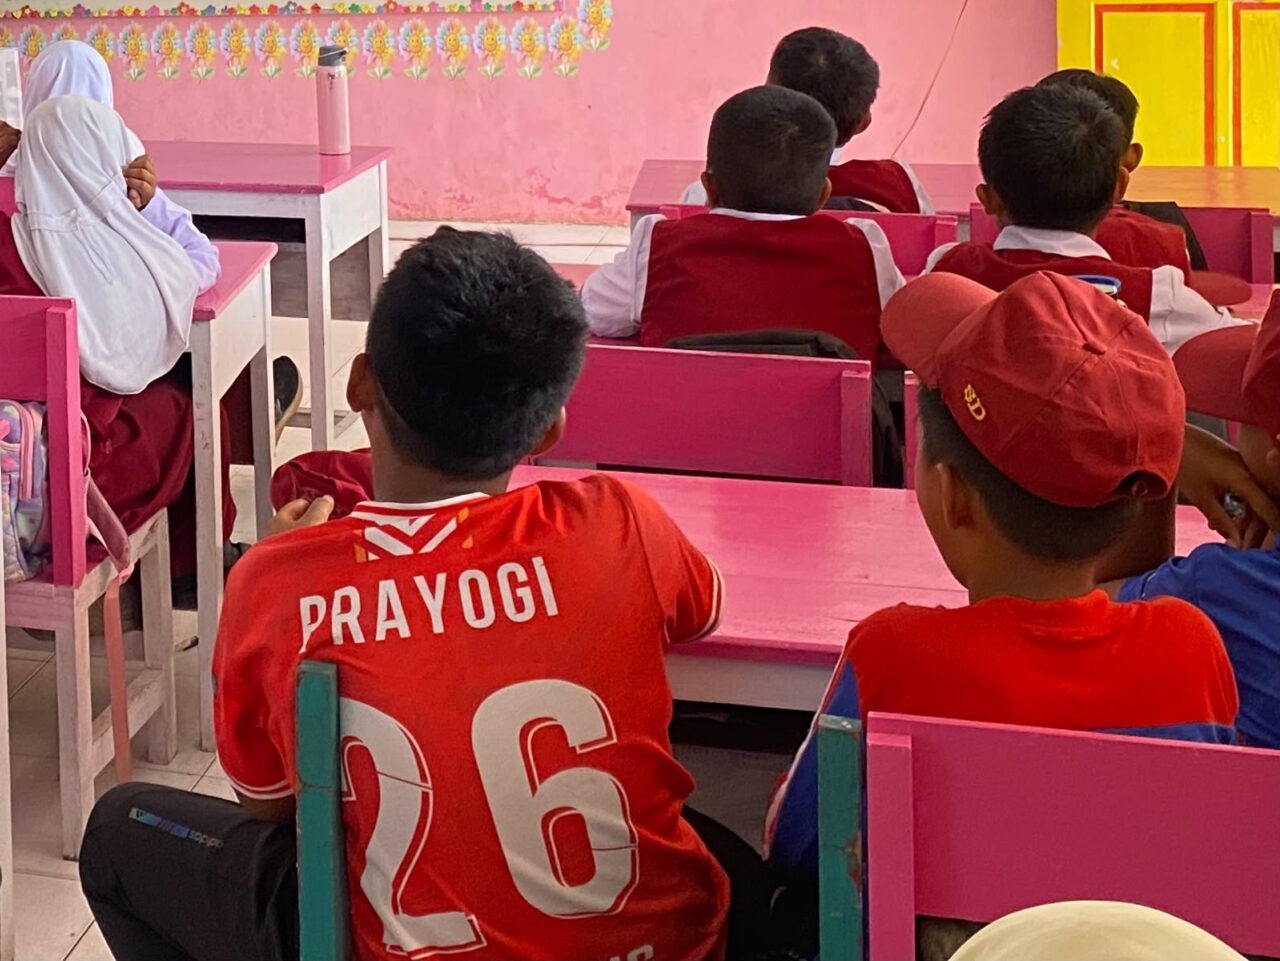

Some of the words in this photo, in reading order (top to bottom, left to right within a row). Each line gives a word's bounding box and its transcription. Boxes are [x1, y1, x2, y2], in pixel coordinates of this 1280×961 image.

[964, 384, 986, 420] SD
[299, 556, 558, 654] PRAYOGI
[339, 678, 640, 960] 26
